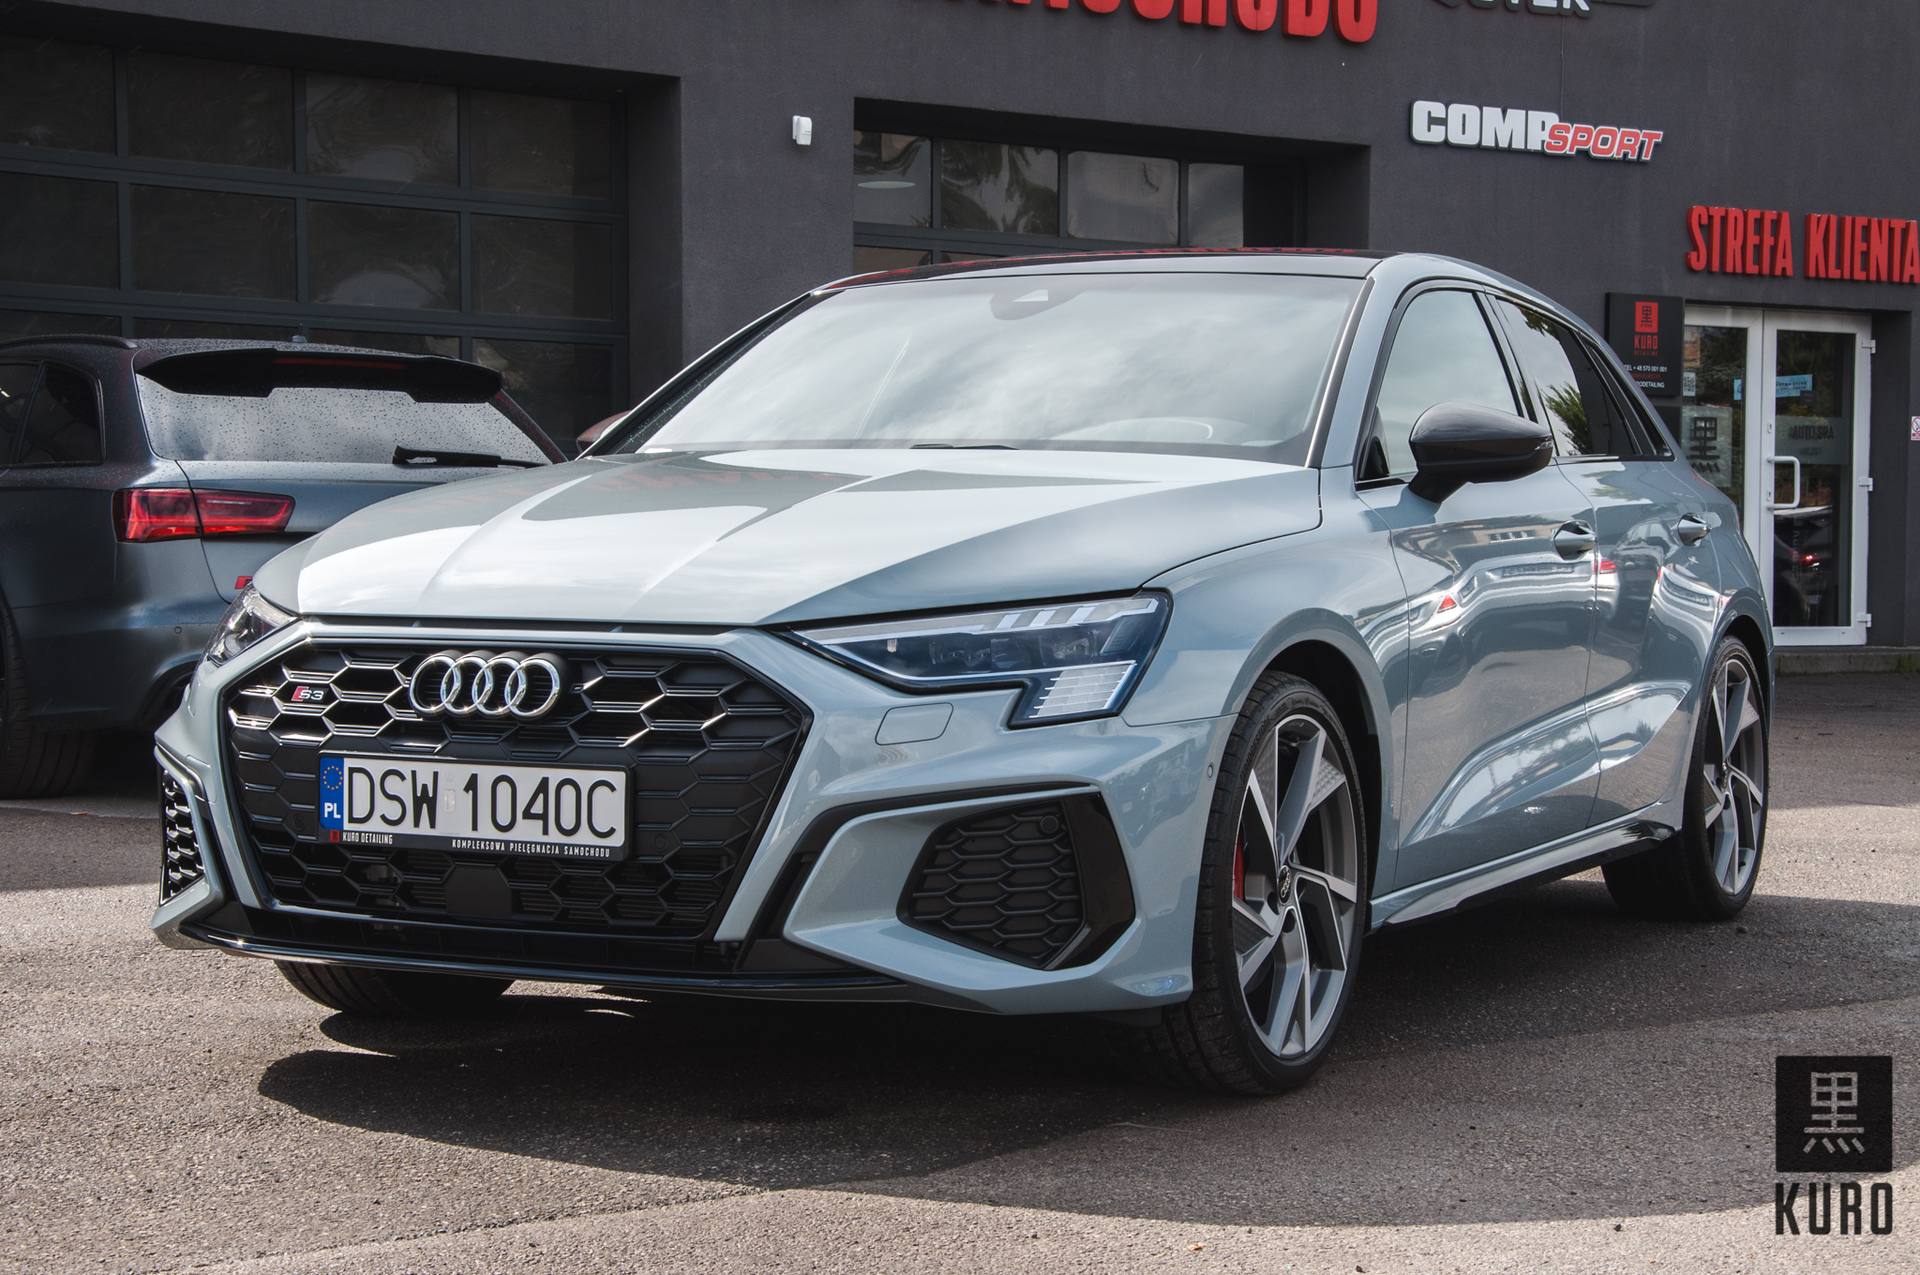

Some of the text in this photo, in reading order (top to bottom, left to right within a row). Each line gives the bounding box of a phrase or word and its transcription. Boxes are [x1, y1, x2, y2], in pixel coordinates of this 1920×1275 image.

[1687, 205, 1920, 284] STREFA KLIENTA
[1634, 335, 1658, 350] KURO
[299, 689, 324, 700] S3
[324, 766, 617, 839] PL DSW 1040C
[342, 832, 360, 843] KURO
[361, 833, 393, 845] DETAILING
[452, 839, 505, 851] KOMPLEKSOWA
[564, 846, 610, 858] SAMOCHODU
